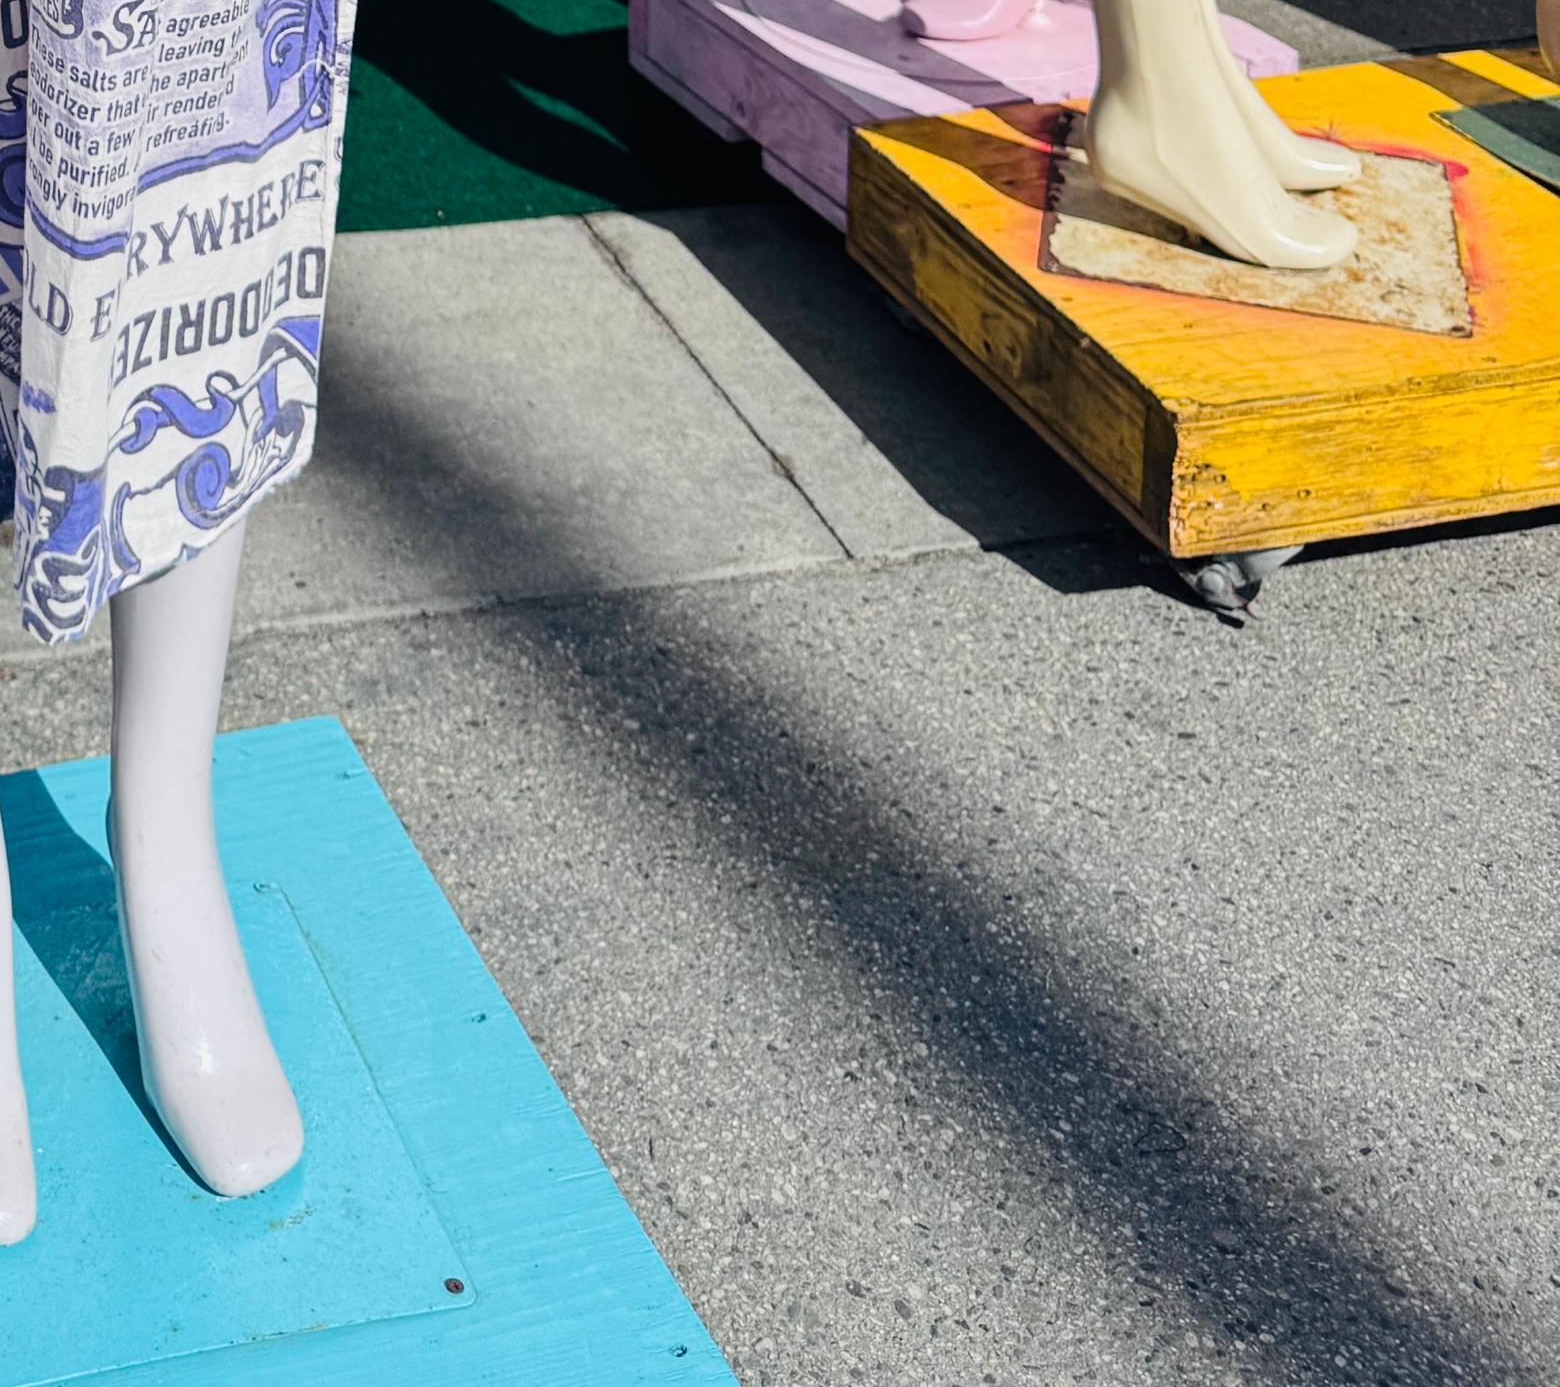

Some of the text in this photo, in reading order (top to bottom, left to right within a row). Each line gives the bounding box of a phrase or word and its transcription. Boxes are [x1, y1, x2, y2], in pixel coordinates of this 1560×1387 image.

[157, 35, 225, 63] leaving
[69, 65, 117, 94] salts
[107, 99, 139, 122] that
[54, 122, 82, 151] out
[87, 138, 99, 157] a
[107, 127, 136, 154] few
[57, 156, 131, 188] purified.
